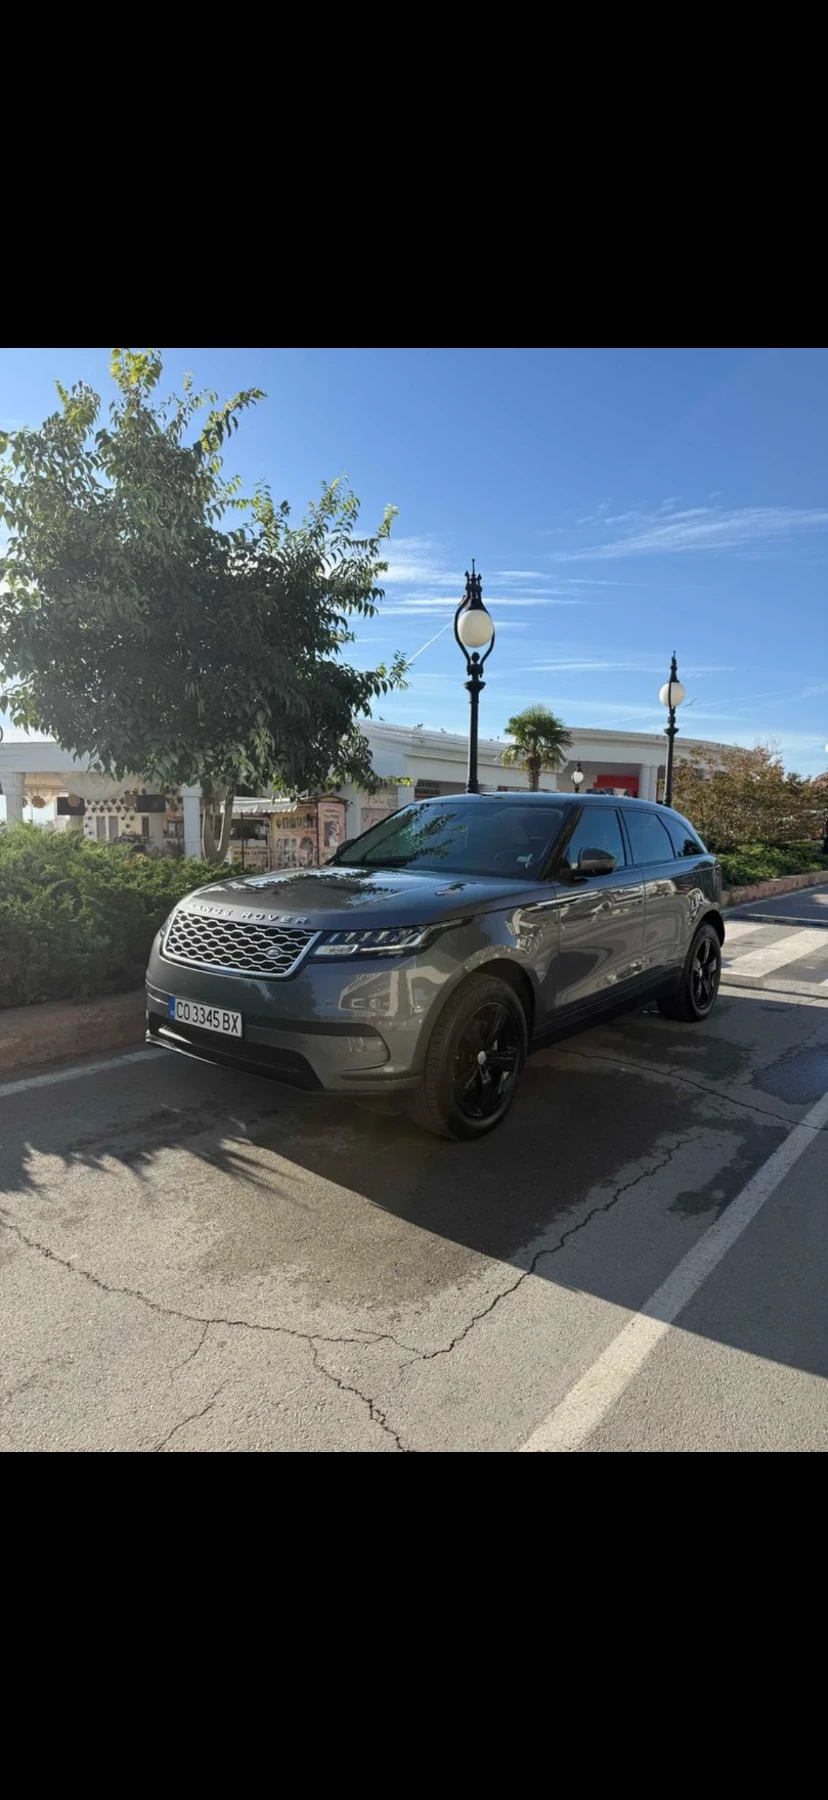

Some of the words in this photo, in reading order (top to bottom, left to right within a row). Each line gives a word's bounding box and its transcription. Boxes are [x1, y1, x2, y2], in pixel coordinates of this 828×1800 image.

[241, 911, 311, 925] ROVER
[176, 1001, 190, 1021] CO
[192, 1005, 220, 1028] 3345
[223, 1013, 240, 1034] BX
